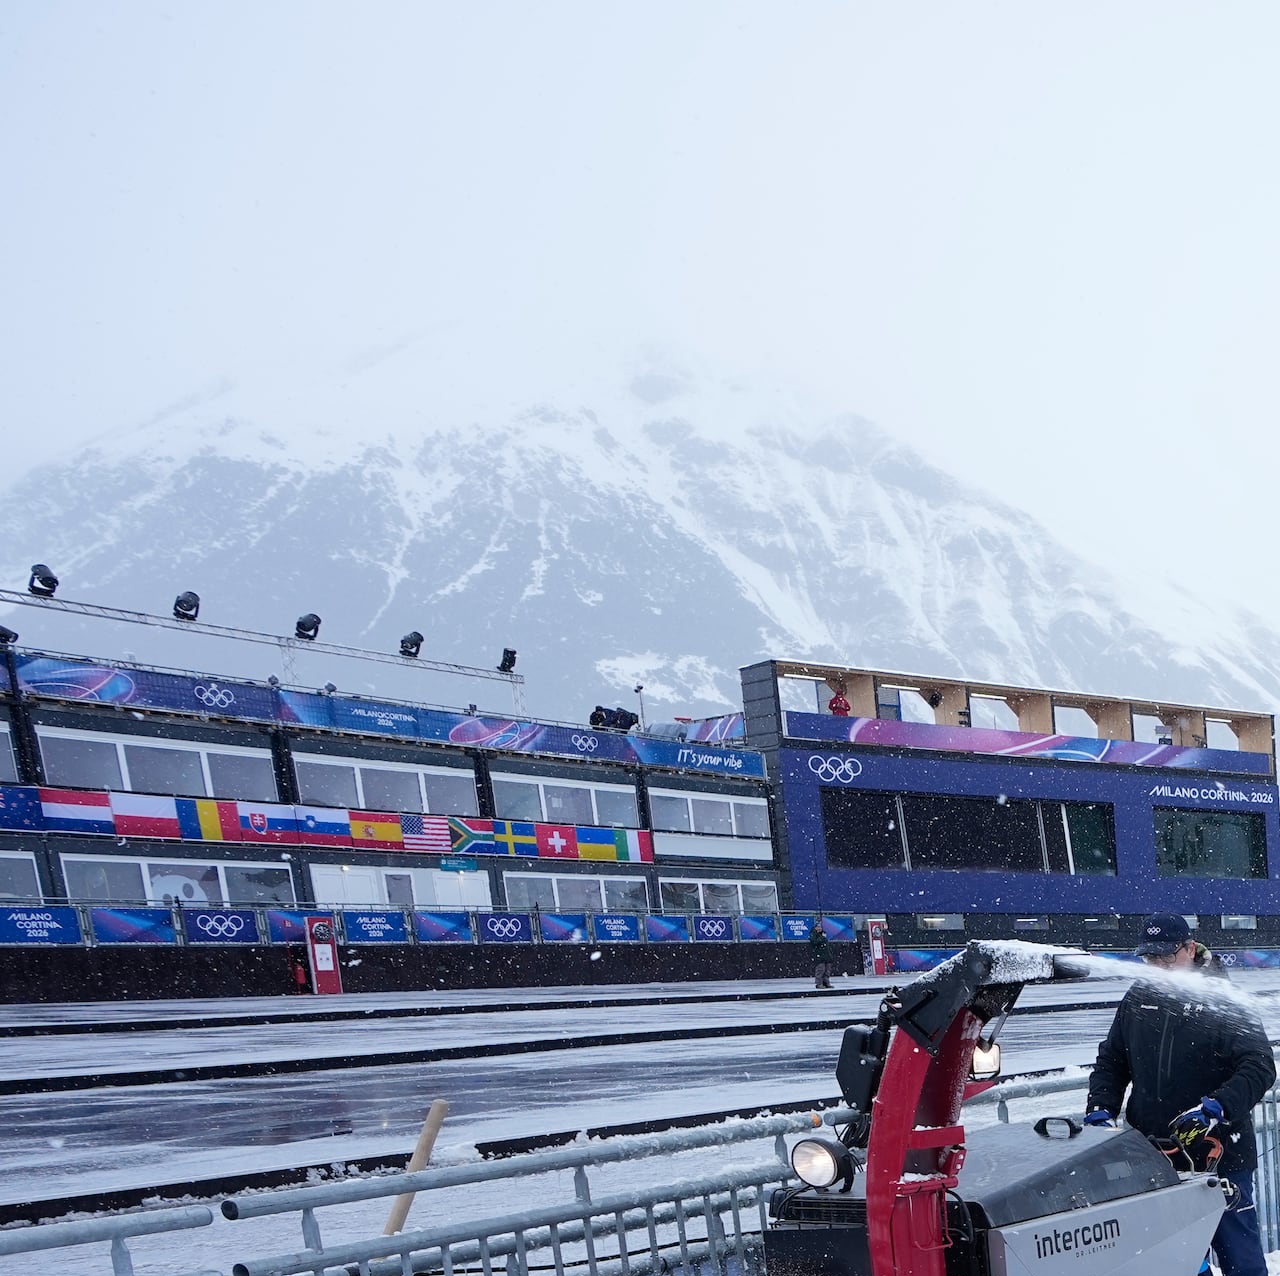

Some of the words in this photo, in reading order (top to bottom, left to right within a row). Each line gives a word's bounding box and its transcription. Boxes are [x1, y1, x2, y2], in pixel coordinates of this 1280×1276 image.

[677, 749, 696, 763] IT's
[696, 754, 722, 767] your
[723, 754, 743, 768] vibe
[1149, 785, 1199, 799] MILANO
[1200, 789, 1249, 802] CORTINA
[1250, 792, 1274, 804] 2026
[7, 912, 52, 921] MILANO
[16, 920, 63, 929] CORTINA
[26, 929, 49, 937] 2026
[1034, 1218, 1121, 1259] intercom
